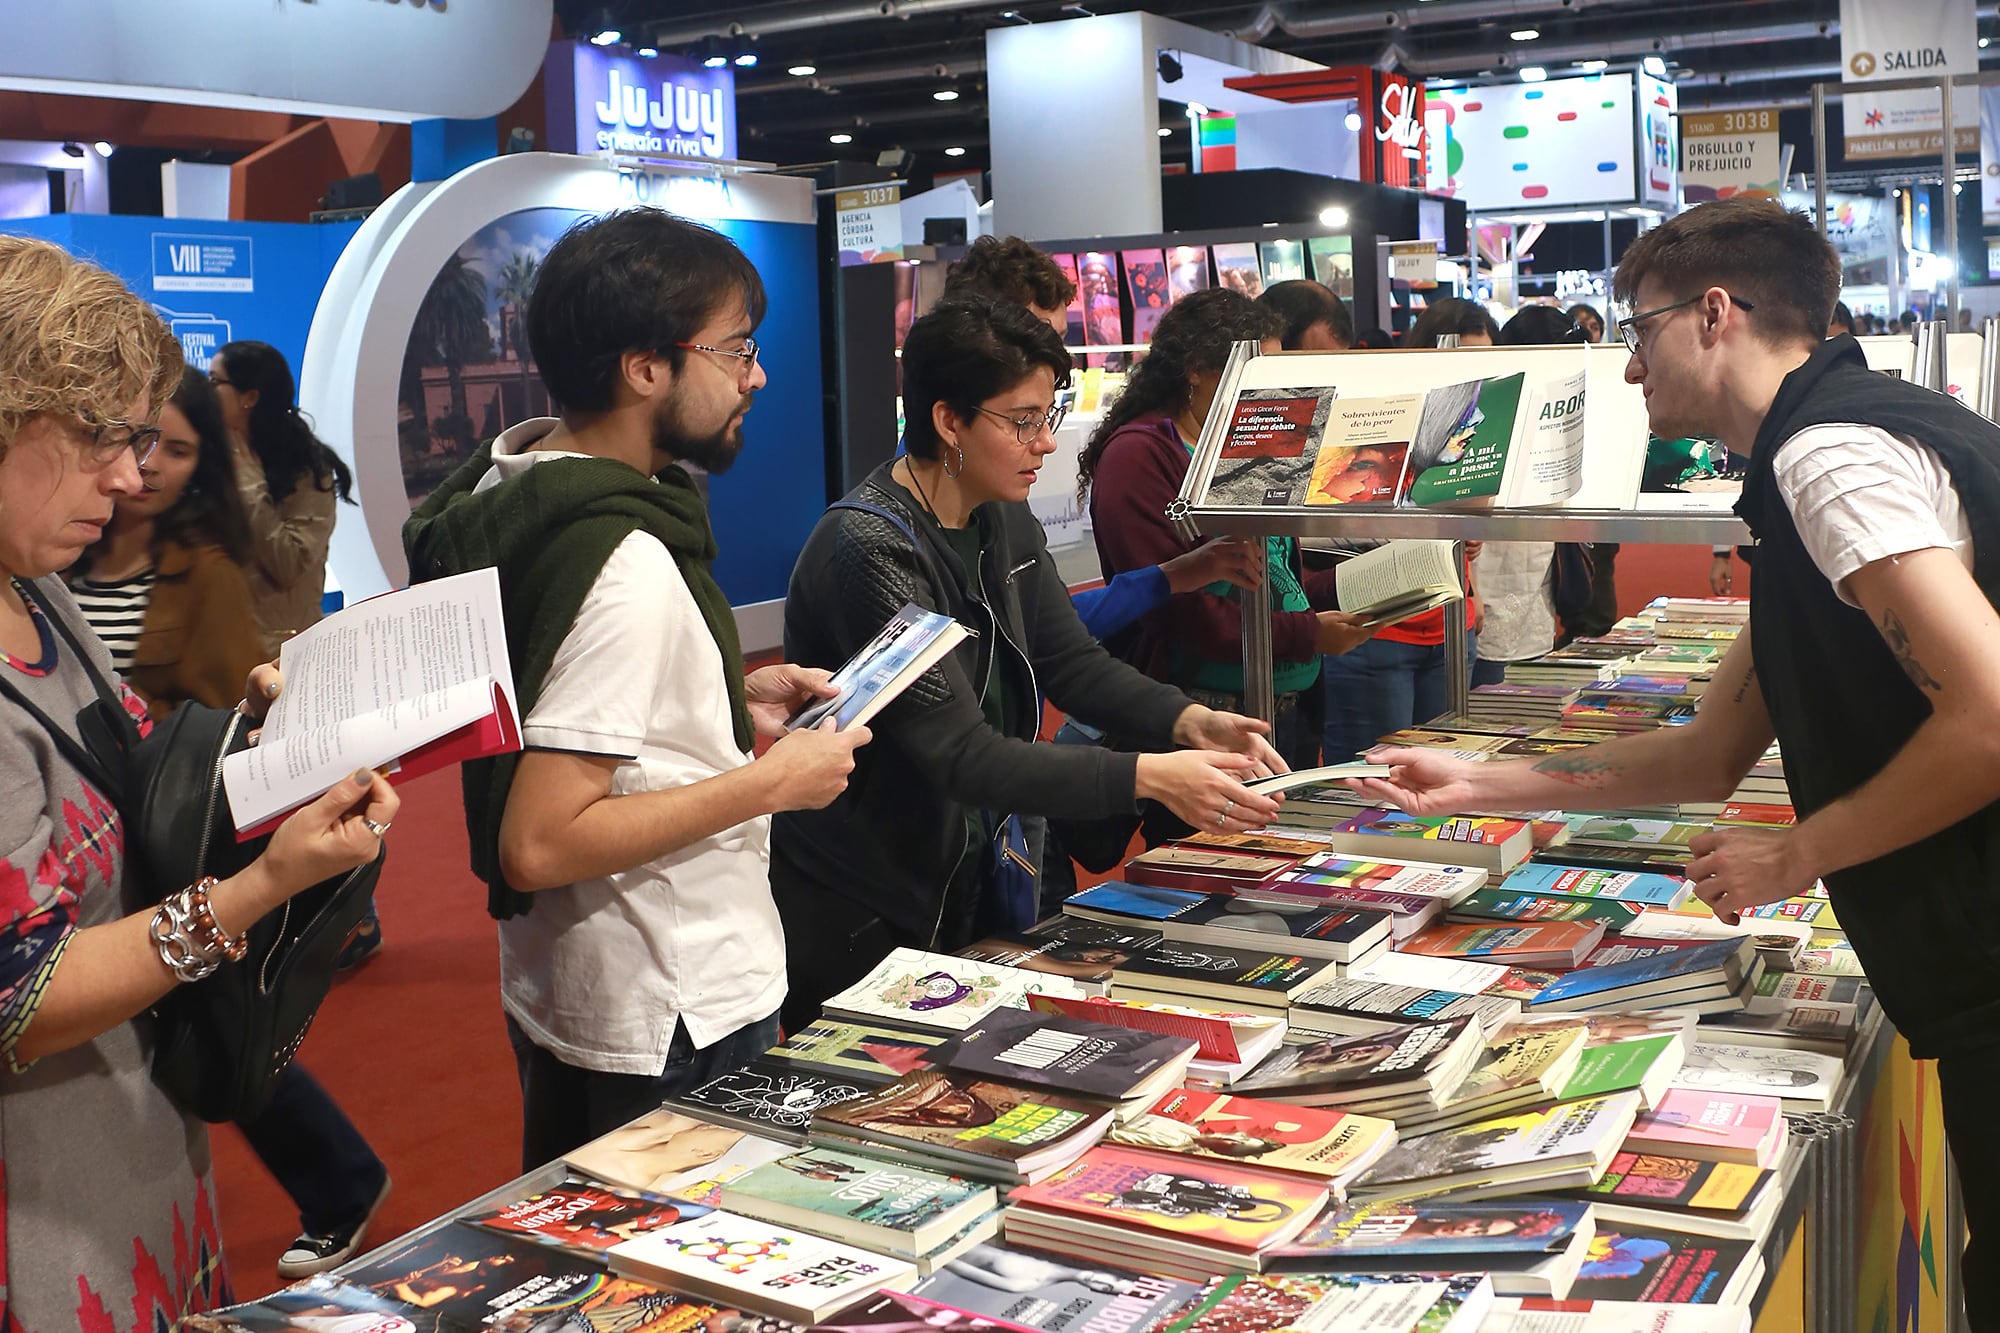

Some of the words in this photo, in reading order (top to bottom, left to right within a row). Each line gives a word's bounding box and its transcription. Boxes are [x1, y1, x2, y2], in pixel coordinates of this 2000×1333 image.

[1884, 49, 1946, 71] SALIDA
[1689, 123, 1715, 133] STAND
[1723, 111, 1770, 131] 3038
[666, 134, 700, 156] viva
[1689, 142, 1743, 156] ORGULLO
[1748, 140, 1755, 152] Y
[1850, 138, 1896, 153] PABELLÓN
[1689, 157, 1752, 172] PREJUICIO
[863, 186, 894, 206] 3037
[842, 213, 871, 224] AGENCIA
[842, 225, 873, 235] CÓRDOBA
[843, 237, 873, 247] CULTURA
[169, 244, 200, 272] VIII
[1397, 258, 1420, 267] JUJUY
[183, 333, 216, 347] FESTIVAL
[1248, 415, 1284, 425] diferencia
[1341, 408, 1406, 419] Sobrevivientes
[1270, 422, 1296, 430] debate
[1350, 420, 1362, 428] de
[1375, 418, 1394, 427] peor
[1464, 447, 1475, 458] A
[1478, 443, 1497, 454] mí
[1476, 455, 1491, 463] me
[1460, 461, 1498, 476] pasar
[1369, 1025, 1433, 1073] REBELDE
[1001, 1102, 1041, 1123] NOS
[1027, 1106, 1063, 1126] QUE
[954, 1122, 998, 1142] VEN
[1010, 1111, 1084, 1145] AHORA
[1305, 1125, 1360, 1162] LUXEMBURGO
[838, 1172, 910, 1201] SOLOS
